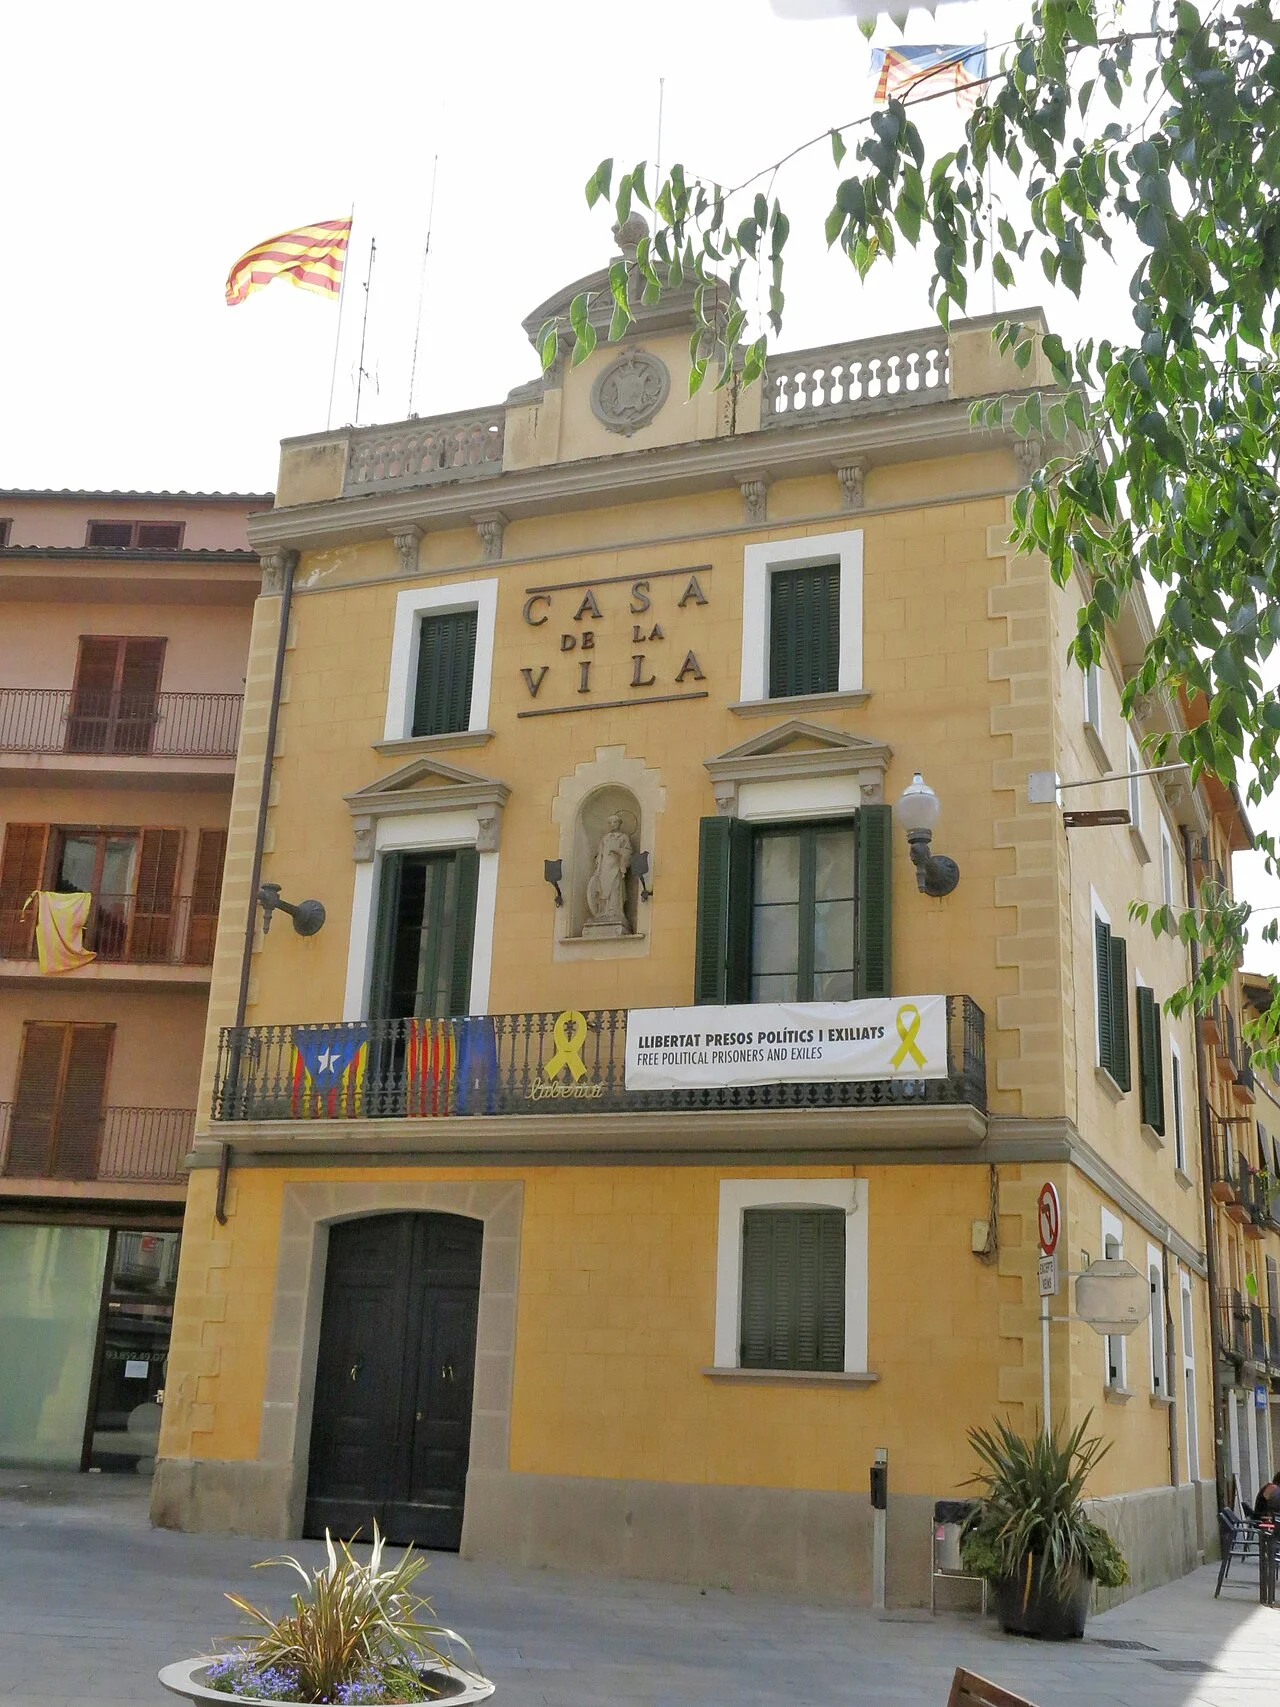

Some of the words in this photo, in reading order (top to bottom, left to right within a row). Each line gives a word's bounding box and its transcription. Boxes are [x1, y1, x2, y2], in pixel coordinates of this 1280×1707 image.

[522, 575, 709, 626] CASA
[560, 631, 595, 651] DE
[632, 623, 664, 643] LA
[520, 649, 707, 698] VILA
[638, 1034, 701, 1048] LLIBERTAT
[705, 1032, 753, 1047] PRESOS
[757, 1027, 814, 1044] POLÍTICS
[818, 1029, 823, 1042] I
[828, 1026, 885, 1042] EXILIATS
[637, 1052, 659, 1066] FREE
[662, 1050, 709, 1065] POLITICAL
[712, 1049, 764, 1064] PRISONERS
[767, 1047, 788, 1061] AND
[791, 1046, 823, 1060] EXILES
